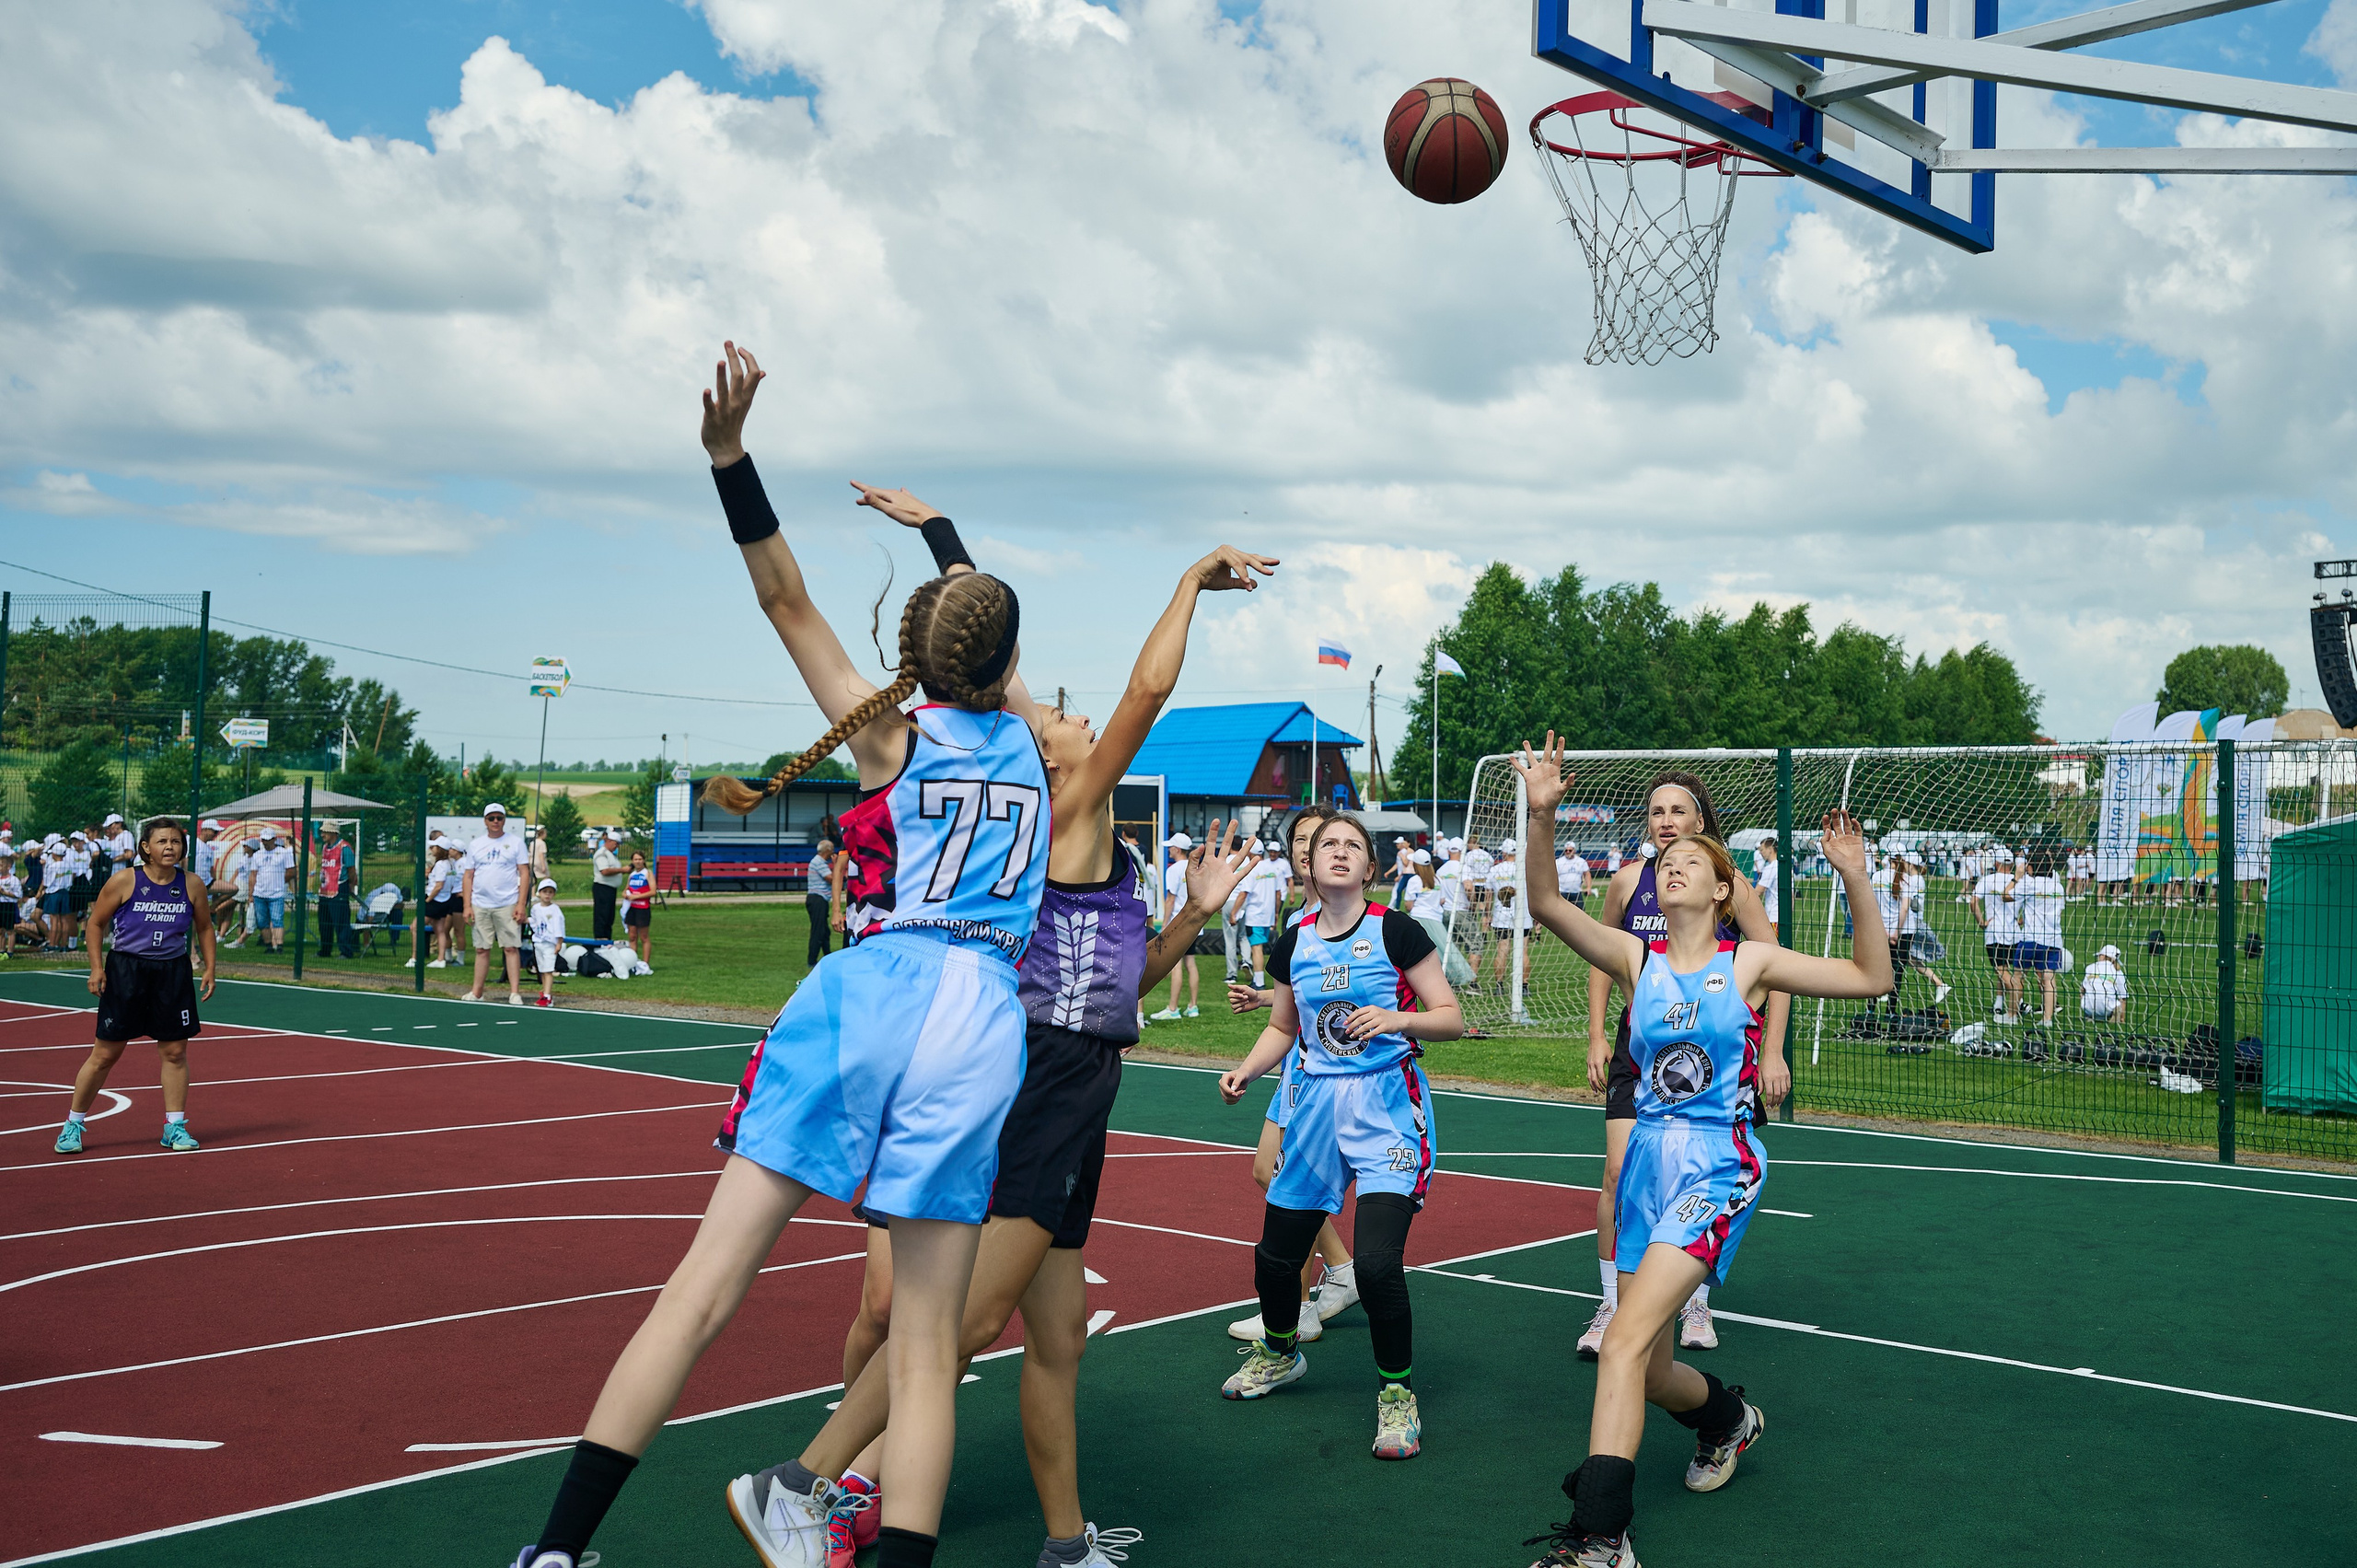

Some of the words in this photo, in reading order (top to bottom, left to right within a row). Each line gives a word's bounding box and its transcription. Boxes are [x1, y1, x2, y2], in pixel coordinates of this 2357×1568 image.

[532, 672, 563, 681] БАСКЕТБОЛ
[232, 728, 266, 737] ФУД-КОРТ
[919, 778, 1041, 903] 77
[132, 900, 188, 914] БИЙСКИЙ
[144, 912, 177, 923] РАЙОН
[152, 931, 164, 947] 9
[1354, 945, 1370, 953] РФБ
[1320, 963, 1351, 993] 23
[1706, 978, 1724, 988] РФБ
[181, 1009, 190, 1027] 9
[1663, 997, 1701, 1030] 47
[1699, 1052, 1713, 1072] КЛУБ
[1387, 1148, 1419, 1174] 23
[1676, 1194, 1719, 1224] 47
